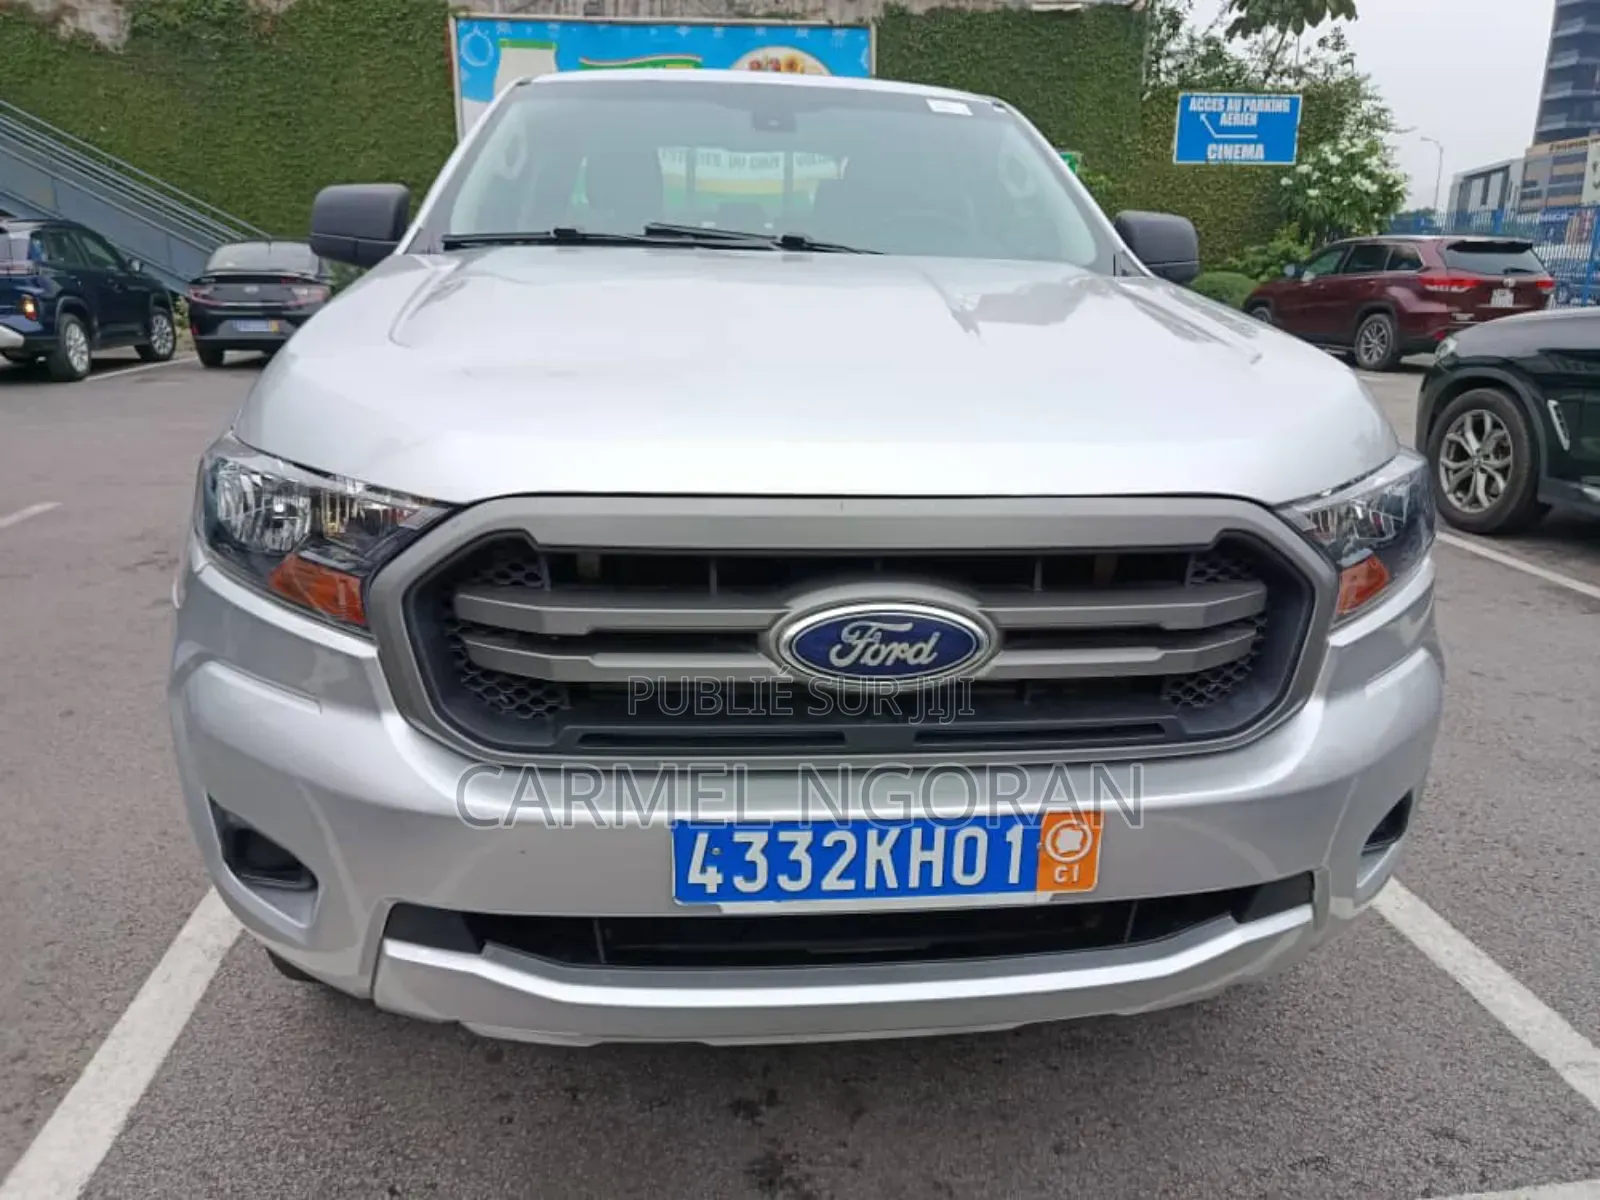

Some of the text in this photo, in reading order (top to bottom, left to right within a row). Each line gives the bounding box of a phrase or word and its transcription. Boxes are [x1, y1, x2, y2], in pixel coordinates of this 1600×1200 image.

[1226, 98, 1243, 112] AU
[1243, 98, 1290, 112] PARKING
[1206, 143, 1264, 160] CINEMA
[829, 620, 941, 667] Ford
[687, 823, 1023, 894] 4332KH01
